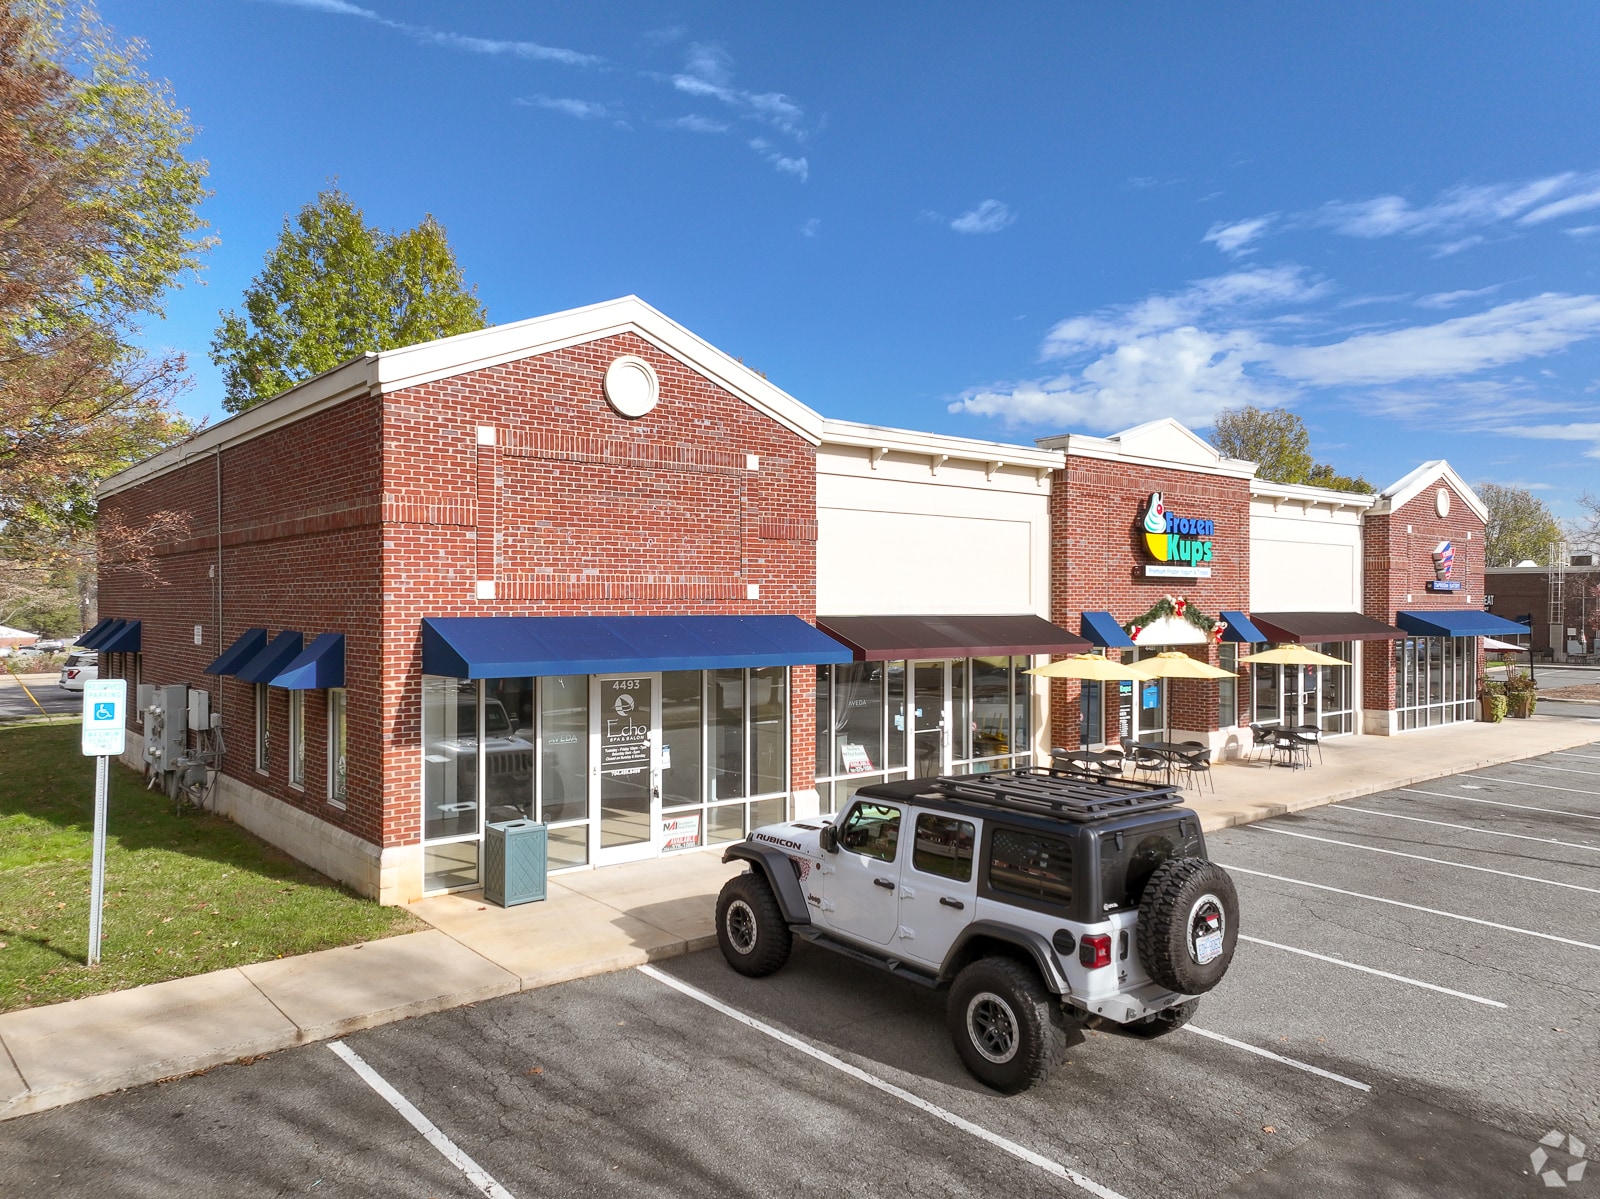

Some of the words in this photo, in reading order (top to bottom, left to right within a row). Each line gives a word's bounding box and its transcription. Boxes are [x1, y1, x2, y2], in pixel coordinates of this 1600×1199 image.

[1166, 512, 1214, 536] Frozen
[1167, 534, 1212, 567] Kups
[612, 680, 640, 690] 4493
[607, 717, 647, 738] Echo
[548, 734, 578, 743] AVEDA
[662, 820, 678, 832] NAI
[671, 836, 694, 844] AVAILABLE
[756, 833, 801, 850] RUBICON
[808, 893, 821, 904] Jeep
